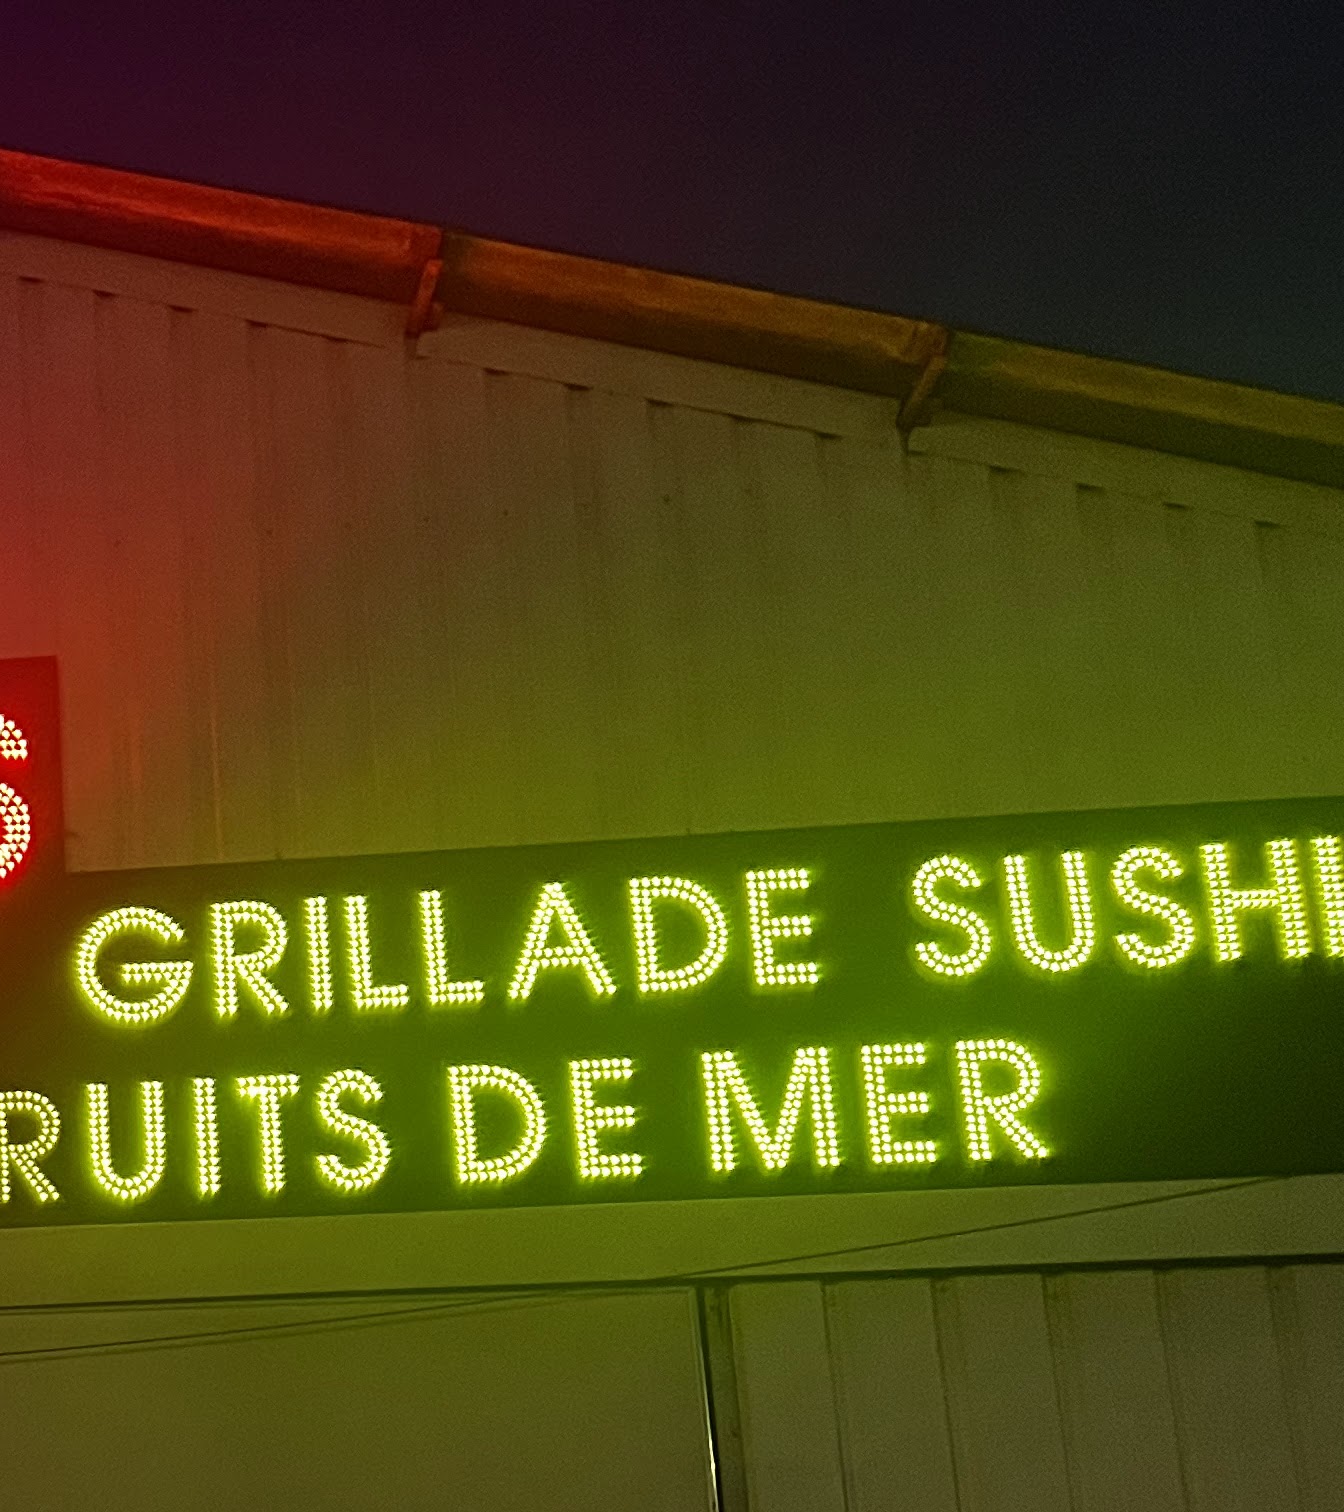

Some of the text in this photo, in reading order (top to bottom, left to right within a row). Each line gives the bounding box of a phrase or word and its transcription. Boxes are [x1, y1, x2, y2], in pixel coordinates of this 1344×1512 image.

[73, 866, 822, 1027] GRILLADE
[911, 833, 1344, 980] SUSHI
[446, 1057, 645, 1187] DE
[700, 1038, 1052, 1174] MER
